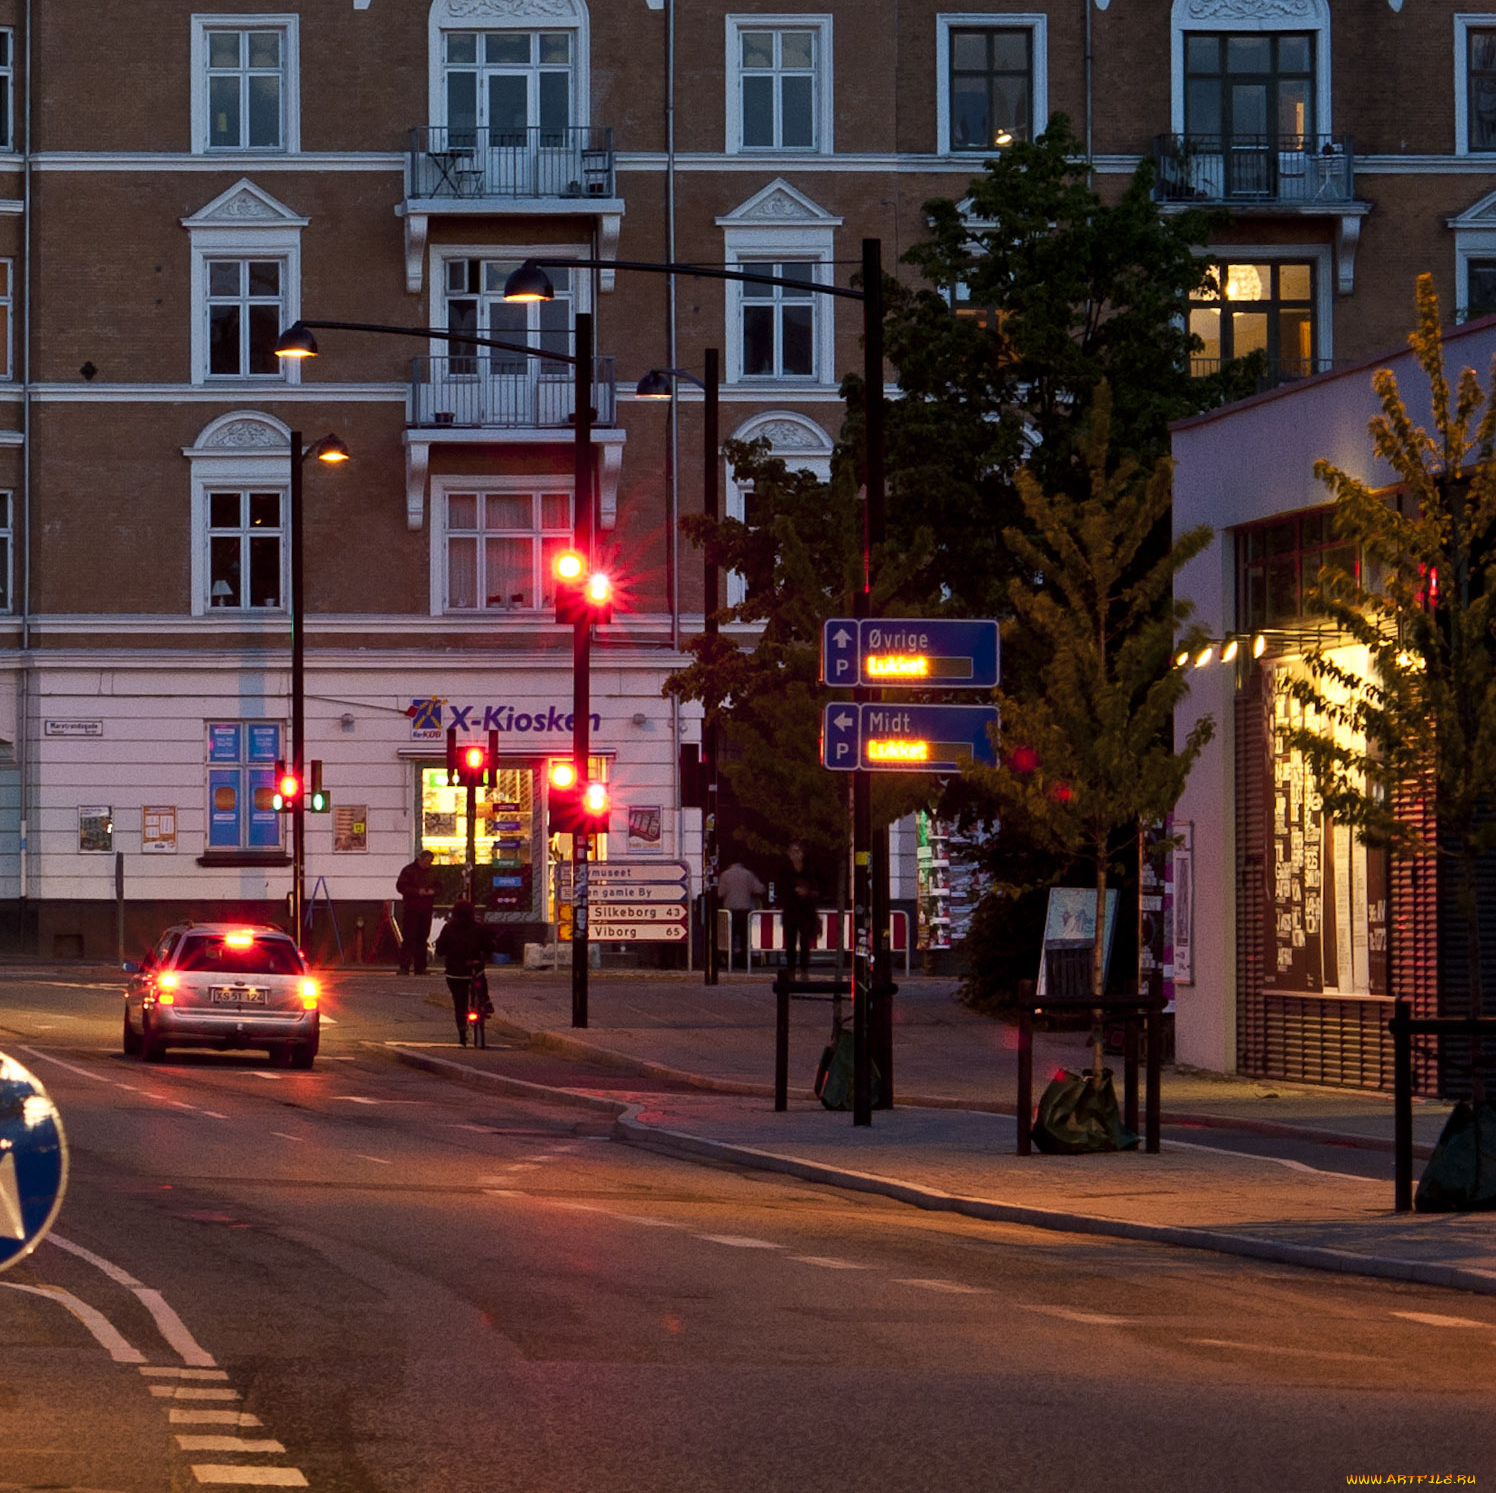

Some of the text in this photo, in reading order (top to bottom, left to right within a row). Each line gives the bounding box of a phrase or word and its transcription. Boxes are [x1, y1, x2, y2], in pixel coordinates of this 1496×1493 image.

[868, 628, 929, 652] Øvrige
[836, 659, 849, 676] P
[867, 655, 929, 676] Lukket
[869, 712, 911, 733] Midt
[836, 743, 849, 760] P
[867, 739, 928, 760] Lukket
[602, 888, 634, 898] gamle
[638, 888, 652, 898] By
[594, 907, 680, 919] Silkeborg 43
[594, 927, 680, 939] Viborg 65
[216, 991, 230, 1001] XS
